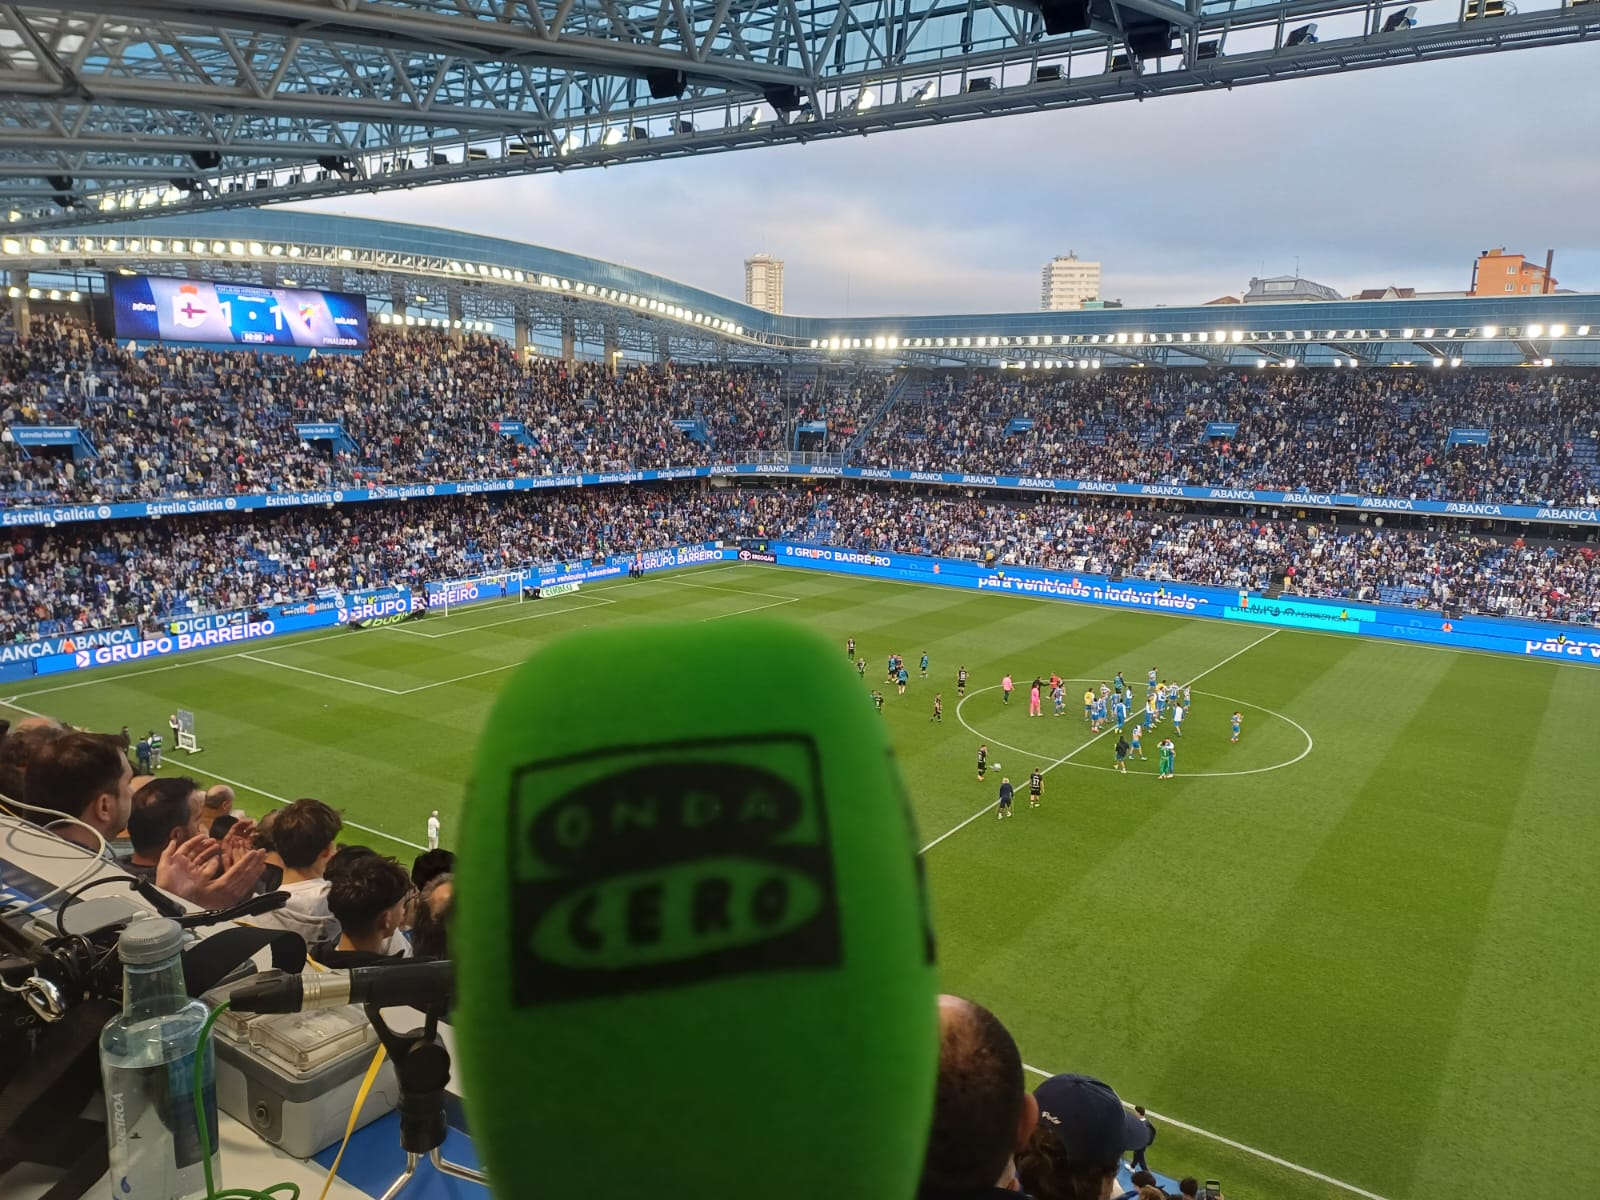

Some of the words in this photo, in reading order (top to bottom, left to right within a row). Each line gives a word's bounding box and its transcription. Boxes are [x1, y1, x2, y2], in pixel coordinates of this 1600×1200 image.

[220, 301, 233, 327] 1
[269, 304, 283, 331] 1
[322, 337, 358, 346] FINALIZADO
[266, 493, 299, 506] Estrella
[301, 491, 332, 505] Galicia
[400, 487, 425, 497] Galicia
[3, 512, 51, 525] Estrella
[53, 508, 95, 522] Galicia
[146, 502, 186, 515] Estrella
[187, 500, 223, 513] Galicia
[643, 556, 675, 569] GRUPO
[677, 550, 723, 564] BARREIRO
[834, 552, 891, 566] BARRERO
[410, 587, 478, 610] BRREIRO
[177, 618, 211, 634] DIGI
[95, 638, 173, 663] GRUPO
[178, 620, 275, 650] BARREIRO
[554, 791, 778, 847] ONDA
[567, 877, 790, 951] CERO
